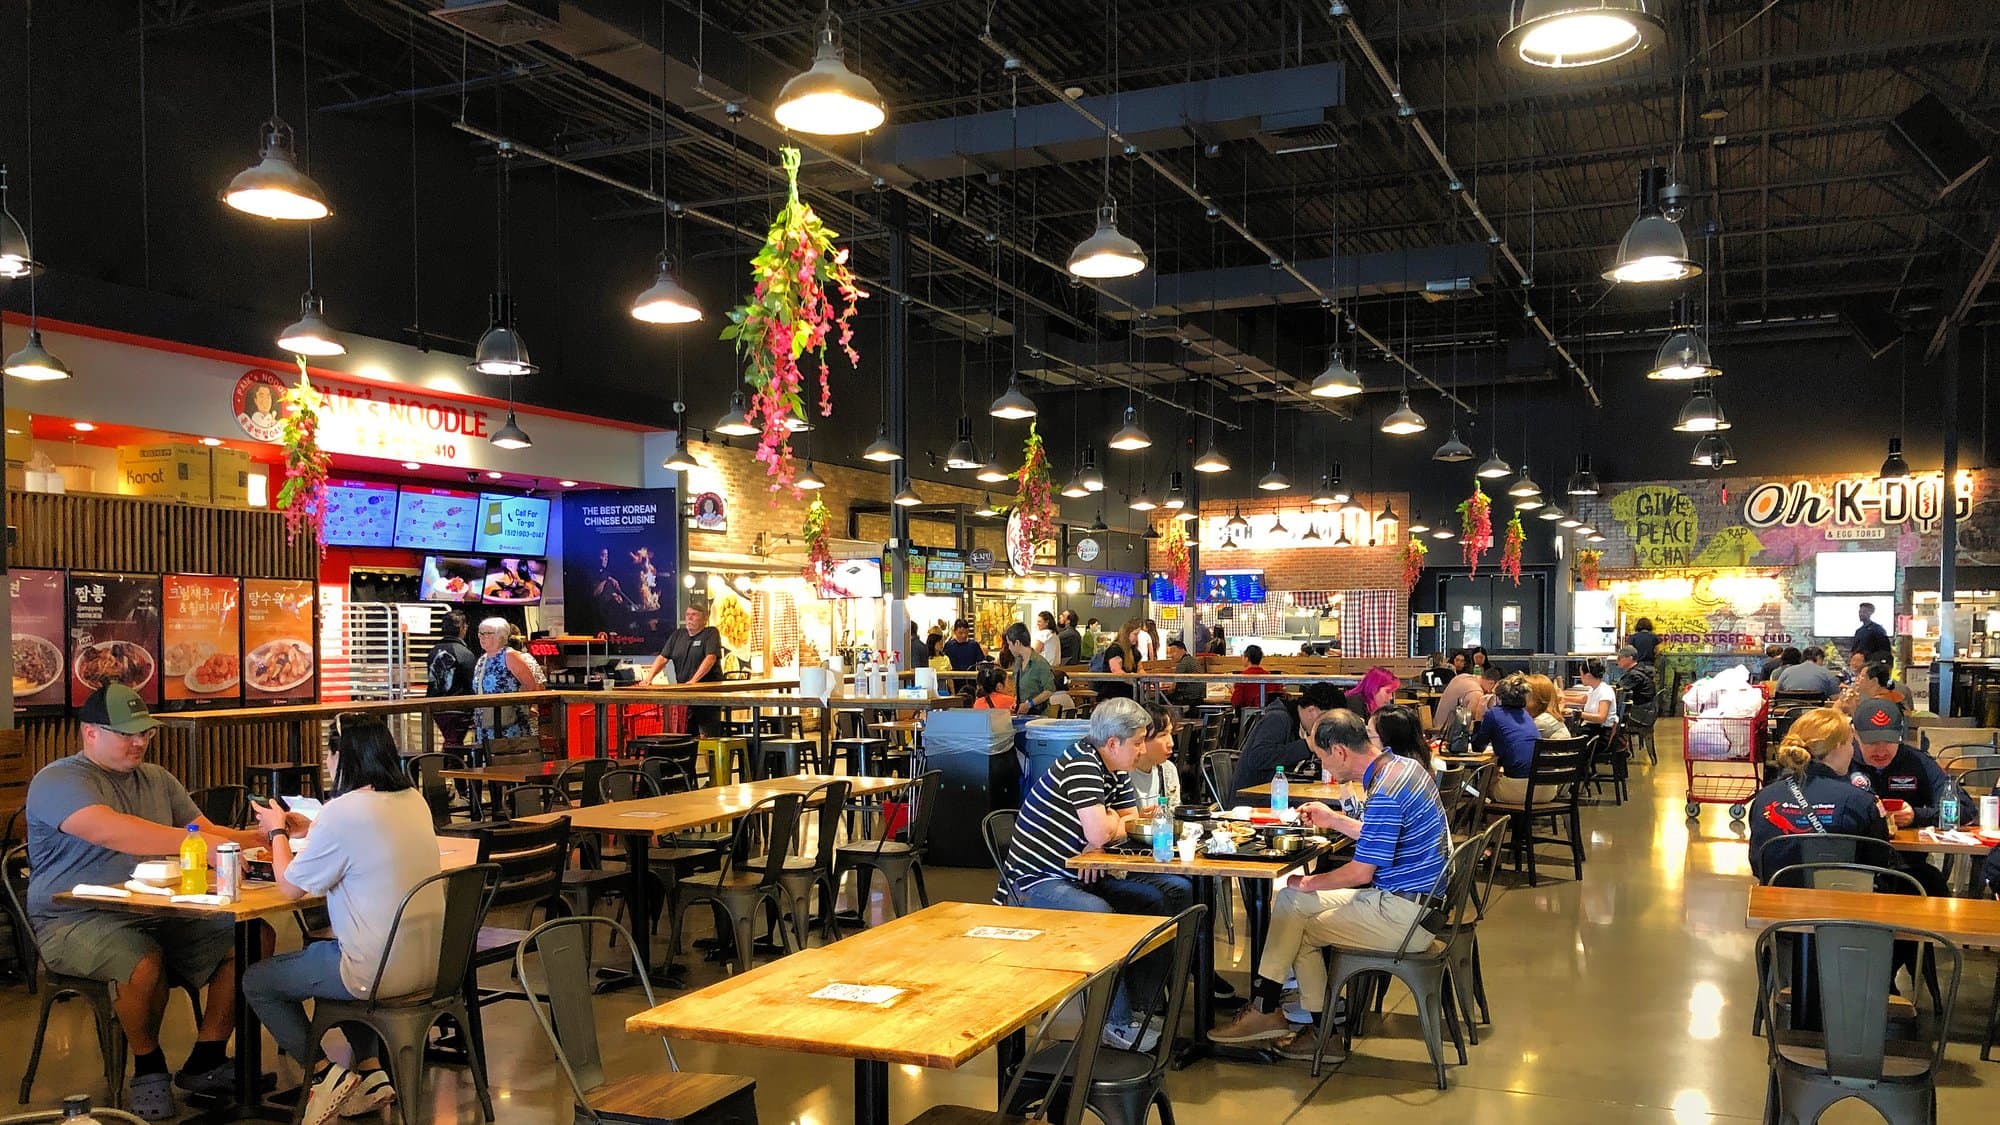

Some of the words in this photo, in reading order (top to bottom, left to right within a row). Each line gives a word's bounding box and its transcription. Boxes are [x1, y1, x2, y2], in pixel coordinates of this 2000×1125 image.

[388, 396, 488, 438] NOODLE
[126, 467, 165, 485] Karat
[582, 506, 599, 515] THE
[600, 505, 621, 515] BEST
[622, 504, 657, 514] KOREAN
[1636, 492, 1688, 517] GIVE
[1745, 480, 1834, 527] Oh
[515, 508, 526, 517] Call
[527, 510, 538, 518] For
[584, 516, 620, 526] CHINESE
[621, 515, 656, 525] CUISINE
[1636, 518, 1692, 545] PEACE
[1728, 527, 1749, 540] RAP
[75, 584, 106, 603] 짬뽕
